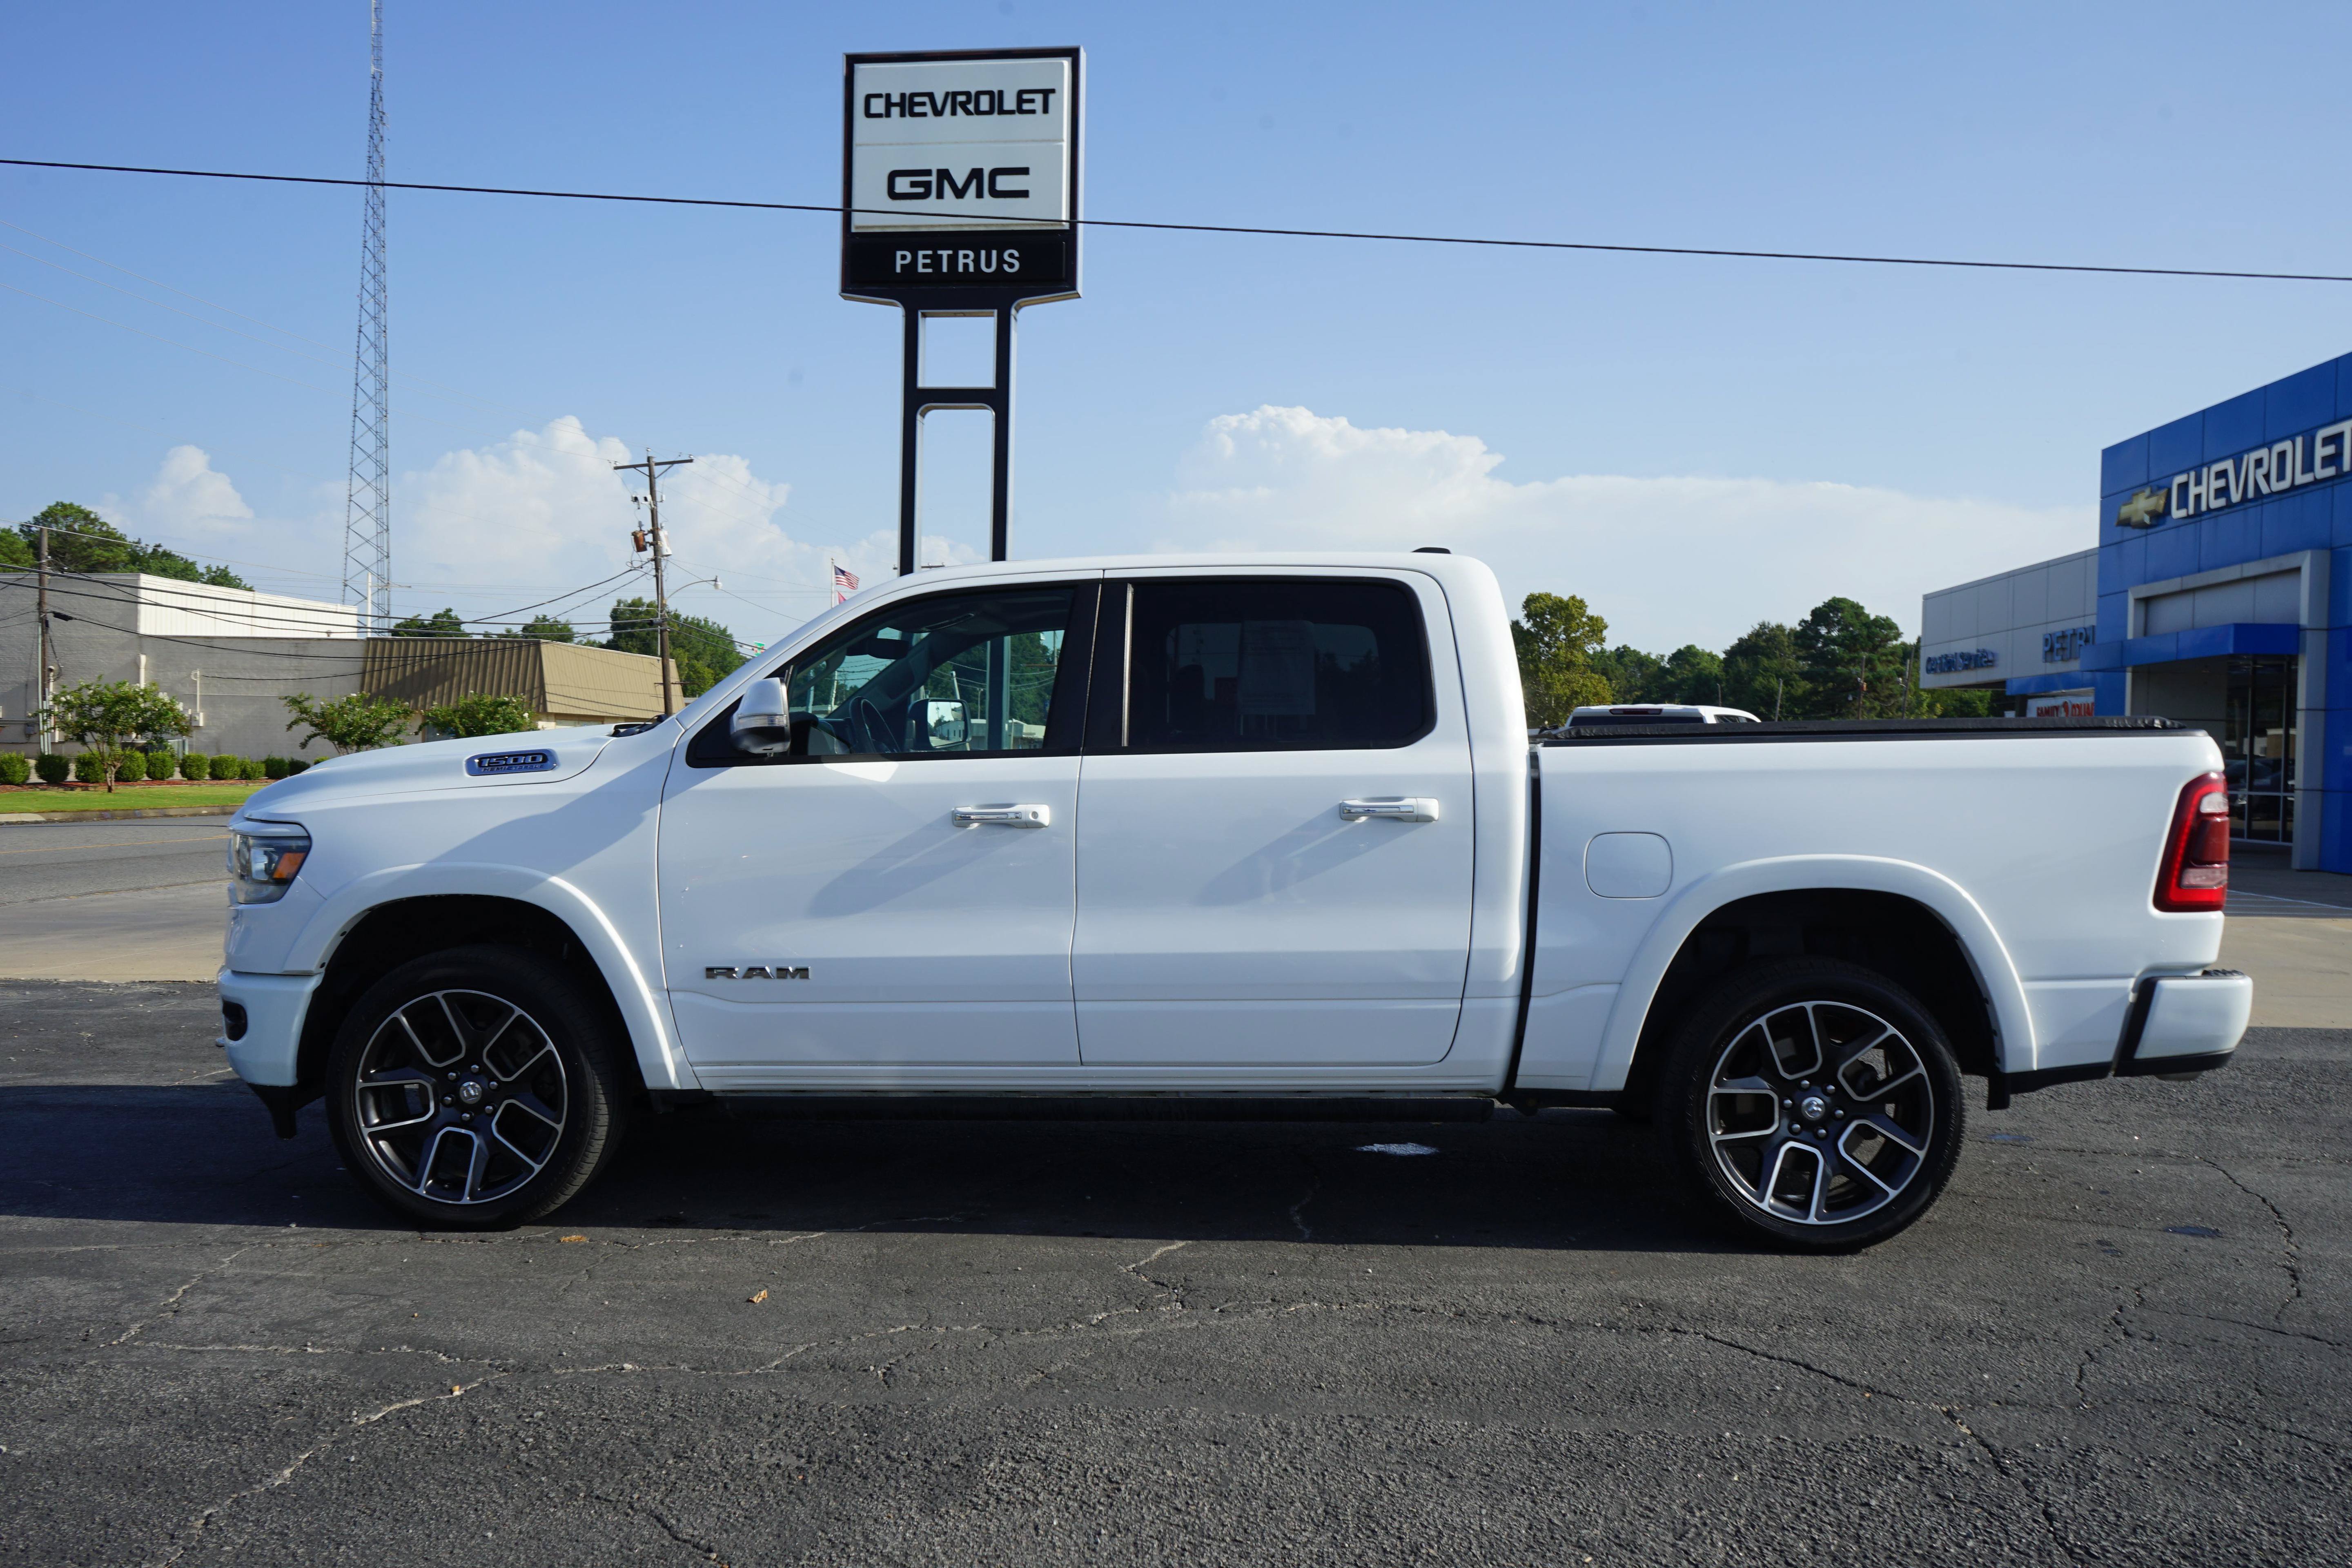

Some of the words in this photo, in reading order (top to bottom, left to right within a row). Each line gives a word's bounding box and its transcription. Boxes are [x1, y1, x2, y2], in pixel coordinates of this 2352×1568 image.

[864, 88, 1056, 118] CHEVROLET
[887, 167, 1029, 200] GMC
[895, 249, 1020, 273] PETRUS
[480, 755, 543, 767] 1500
[705, 966, 811, 979] RAM
